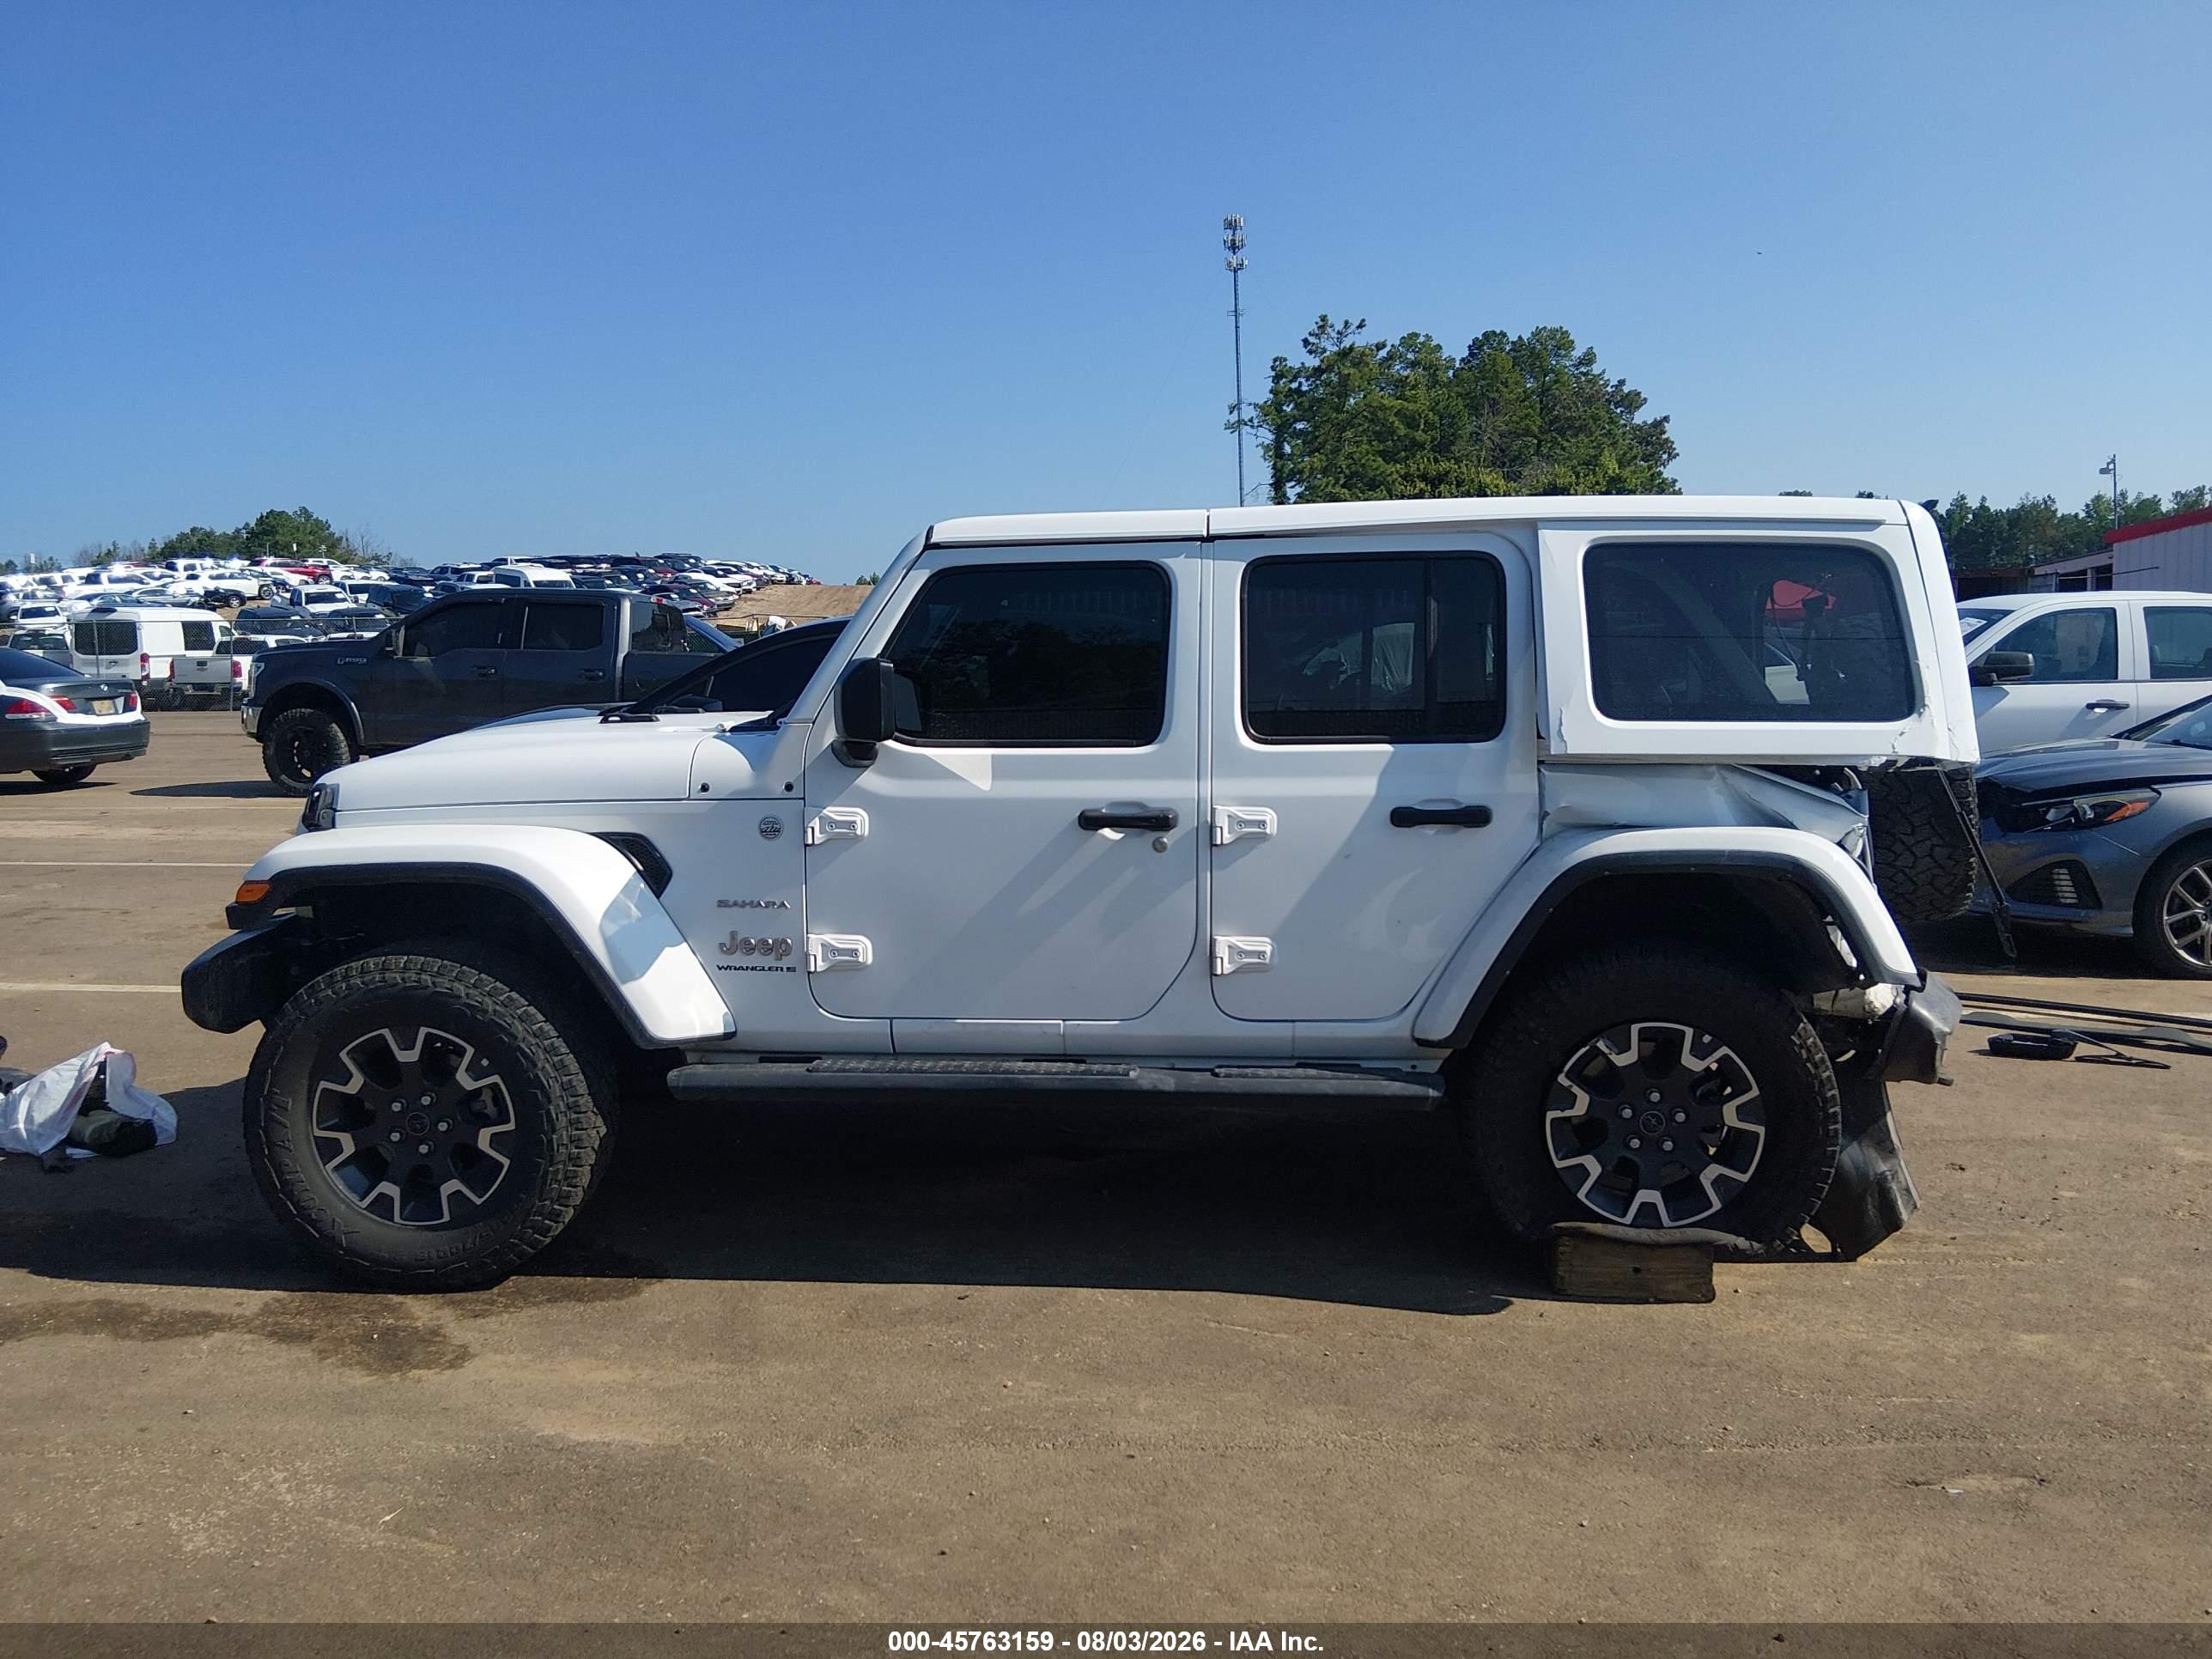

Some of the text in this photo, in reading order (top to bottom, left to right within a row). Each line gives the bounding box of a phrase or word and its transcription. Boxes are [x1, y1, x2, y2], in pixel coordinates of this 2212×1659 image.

[716, 899, 791, 909] SAHARA
[719, 930, 793, 961] Jeep
[715, 963, 785, 973] WRANGLER
